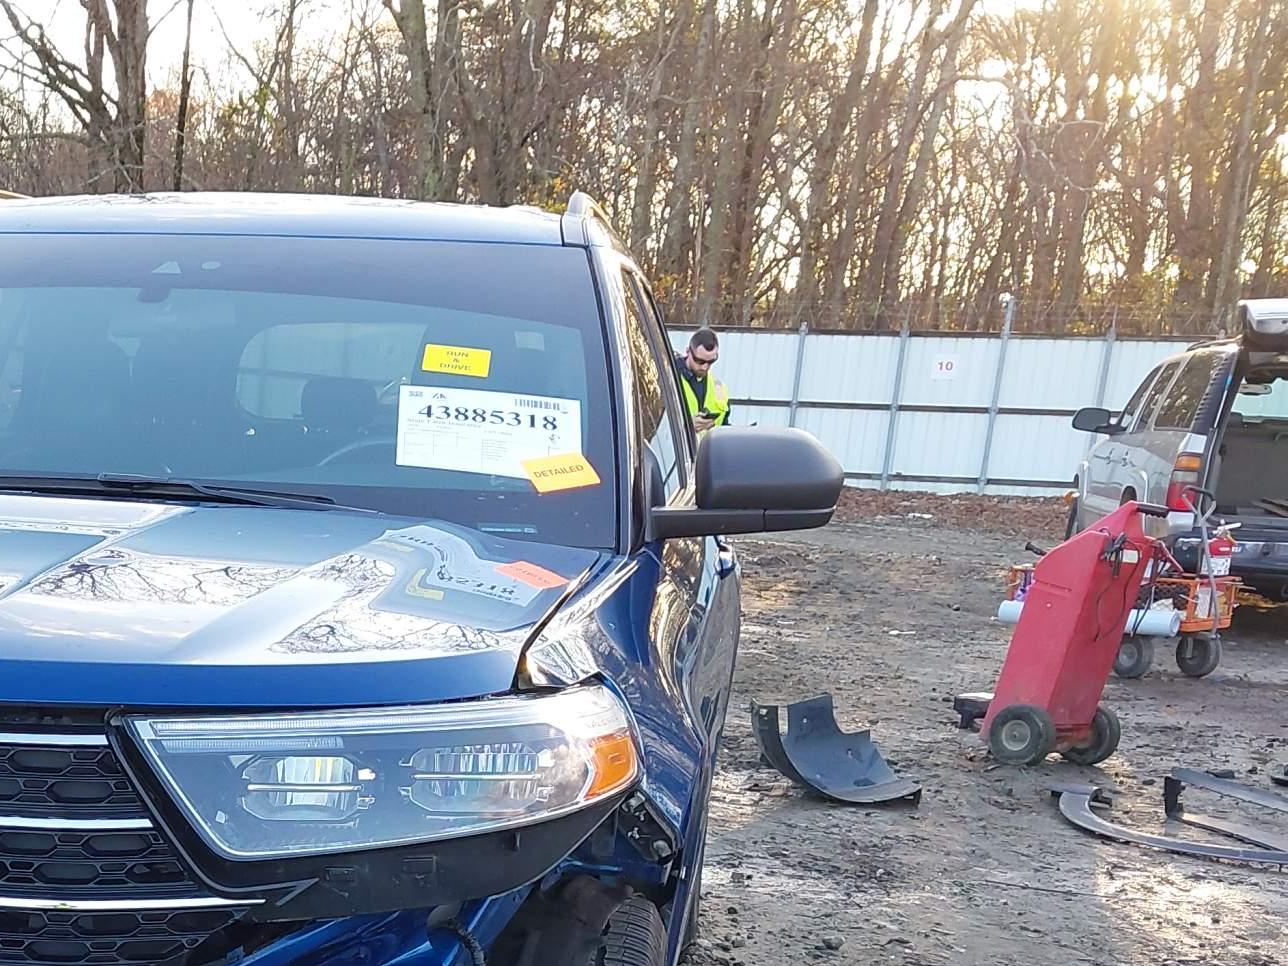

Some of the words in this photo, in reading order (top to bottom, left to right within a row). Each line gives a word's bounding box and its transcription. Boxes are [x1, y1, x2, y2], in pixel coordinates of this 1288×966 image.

[440, 363, 472, 371] DRIVE
[937, 361, 954, 371] 10
[418, 404, 558, 431] 43885318
[533, 464, 585, 479] DETAILED
